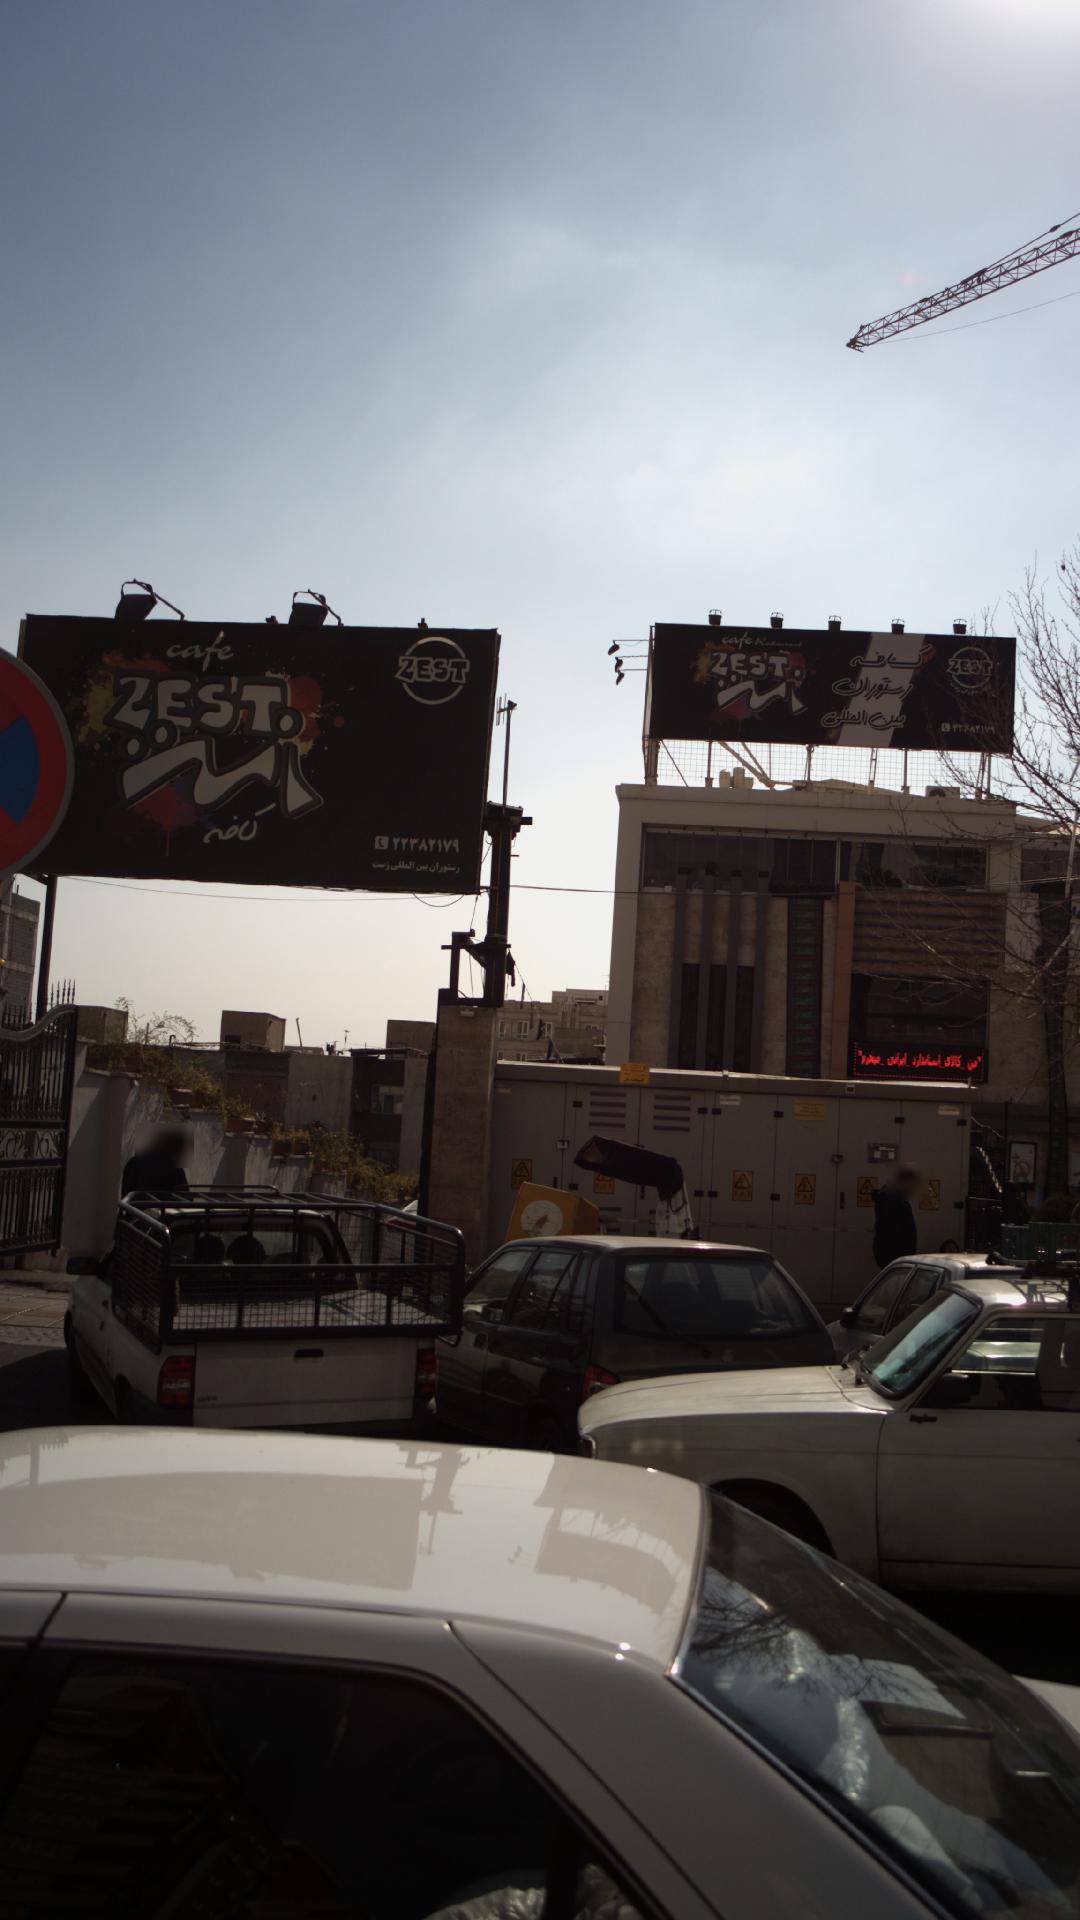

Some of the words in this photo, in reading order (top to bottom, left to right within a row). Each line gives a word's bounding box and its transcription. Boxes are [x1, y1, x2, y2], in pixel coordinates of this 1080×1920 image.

[166, 630, 234, 672] cafe
[720, 632, 752, 649] cafe
[711, 651, 788, 677] ZEST
[850, 644, 932, 669] کافه
[947, 658, 993, 676] ZEST
[395, 655, 470, 684] ZEST
[832, 675, 914, 699] رستوران
[108, 673, 286, 734] ZEST
[820, 705, 868, 728] المللی
[868, 711, 907, 730] بین
[203, 802, 276, 843] کافه
[392, 836, 460, 853] ۲۲۳۸۲۱۷۹
[372, 862, 391, 871] زست
[391, 861, 415, 871] المللی
[415, 863, 429, 872] بین
[429, 861, 461, 874] رستوران
